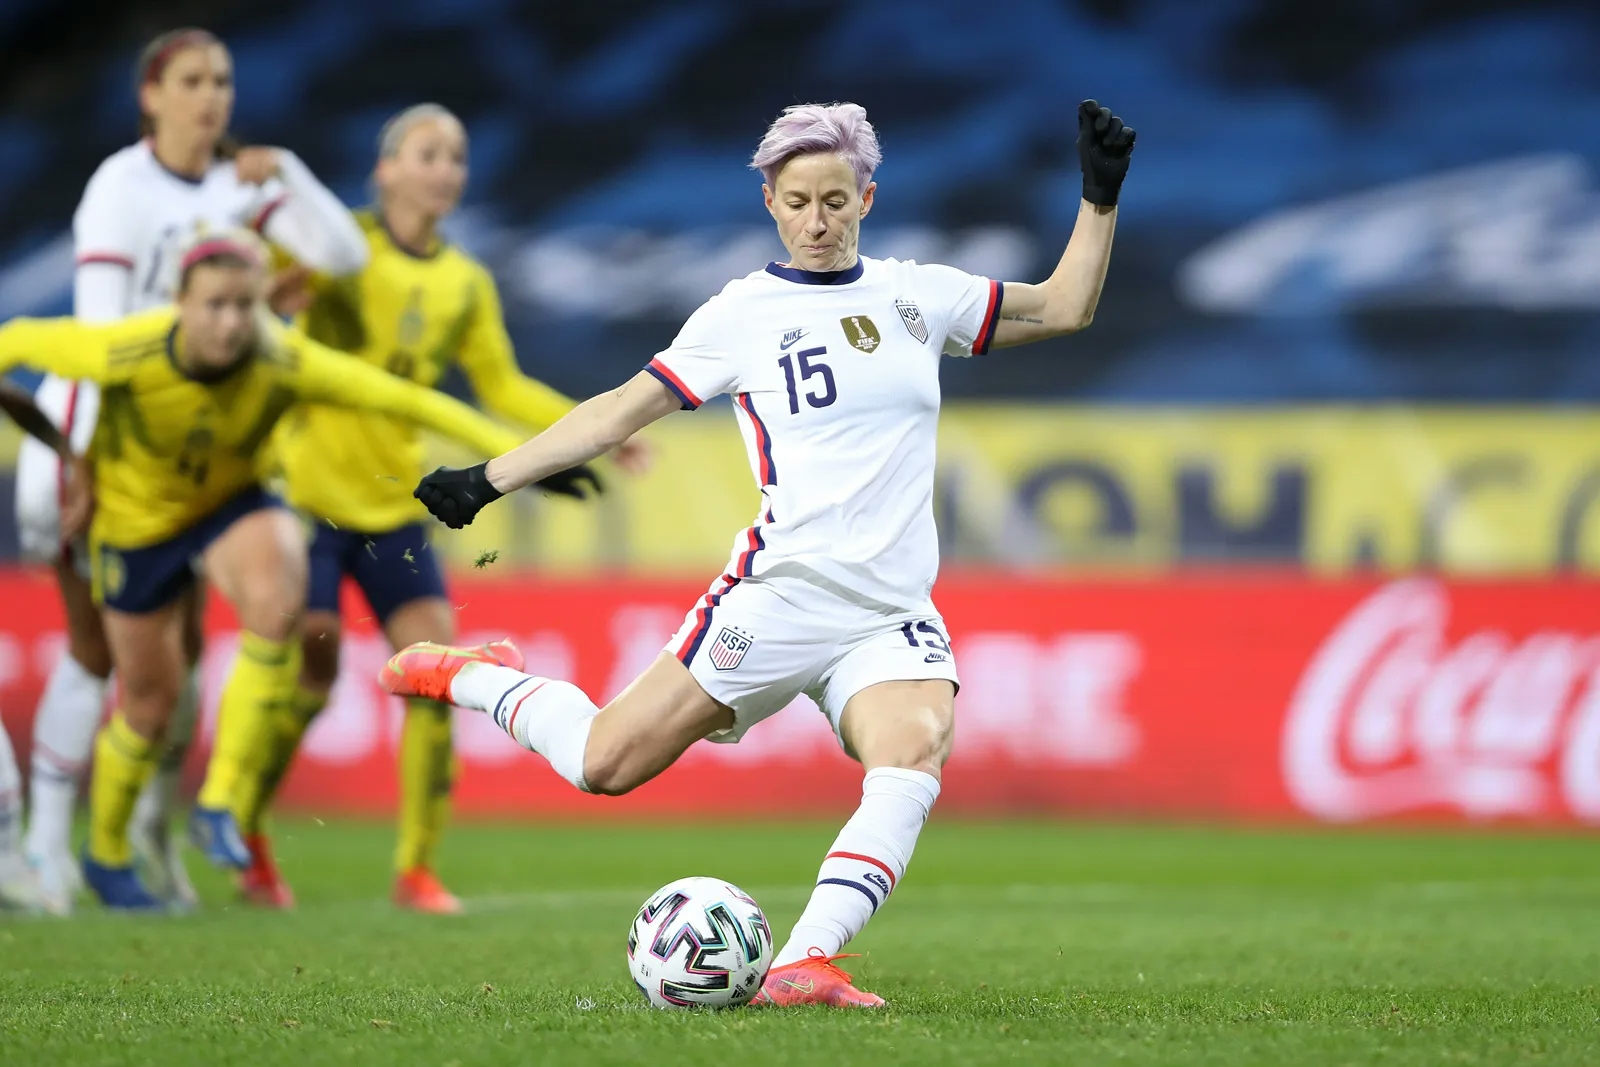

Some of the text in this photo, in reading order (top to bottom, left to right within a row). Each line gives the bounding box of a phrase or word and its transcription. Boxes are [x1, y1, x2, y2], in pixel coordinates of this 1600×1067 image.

[900, 307, 921, 321] USA
[783, 328, 803, 343] NIKE
[777, 345, 838, 415] 15
[721, 631, 748, 652] USA
[900, 620, 951, 655] 15
